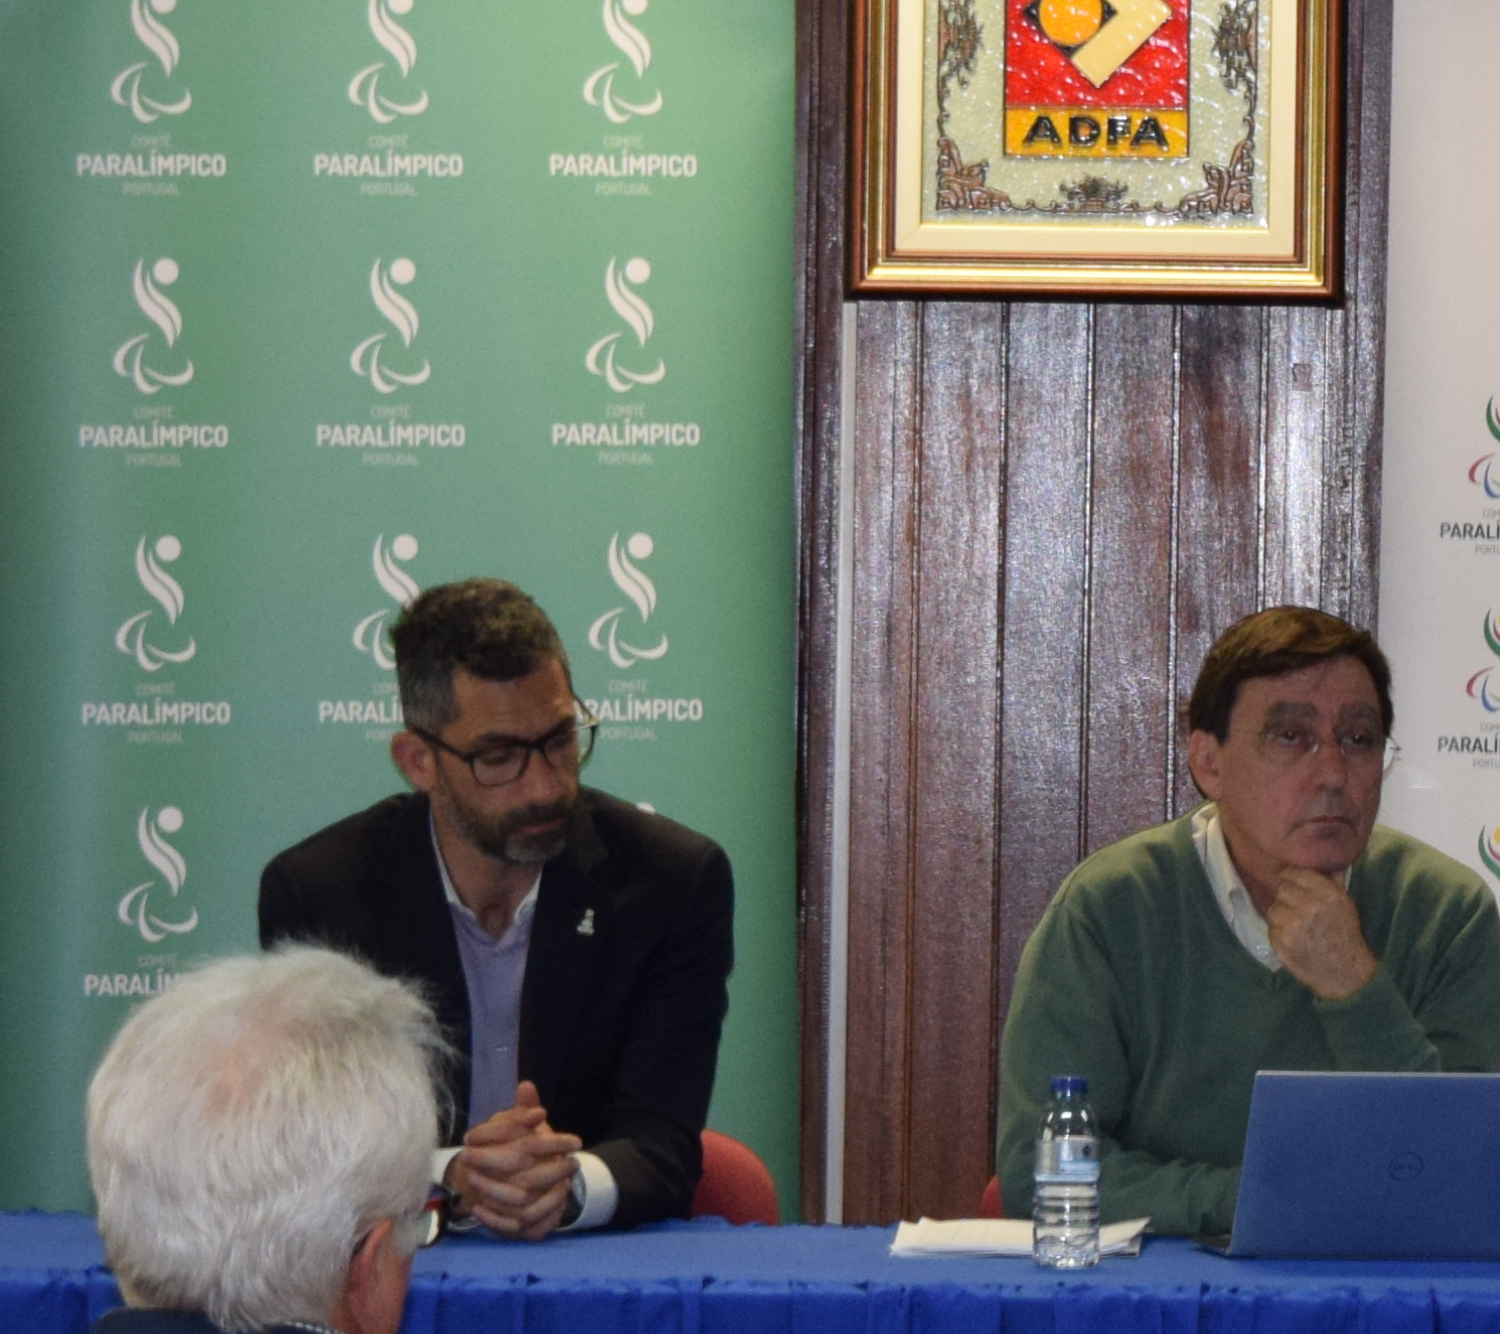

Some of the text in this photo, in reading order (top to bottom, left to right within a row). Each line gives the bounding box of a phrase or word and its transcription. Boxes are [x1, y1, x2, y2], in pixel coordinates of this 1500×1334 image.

[1022, 115, 1169, 150] ADFA
[76, 149, 227, 178] PARALÍMPICO
[314, 149, 464, 178] PARALÍMPICO
[549, 149, 698, 178] PARALÍMPICO
[79, 419, 229, 448] PARALÍMPICO
[316, 419, 466, 448] PARALÍMPICO
[552, 419, 700, 448] PARALÍMPICO
[82, 697, 231, 726] PARALÍMPICO
[319, 695, 404, 724] PARALÍ
